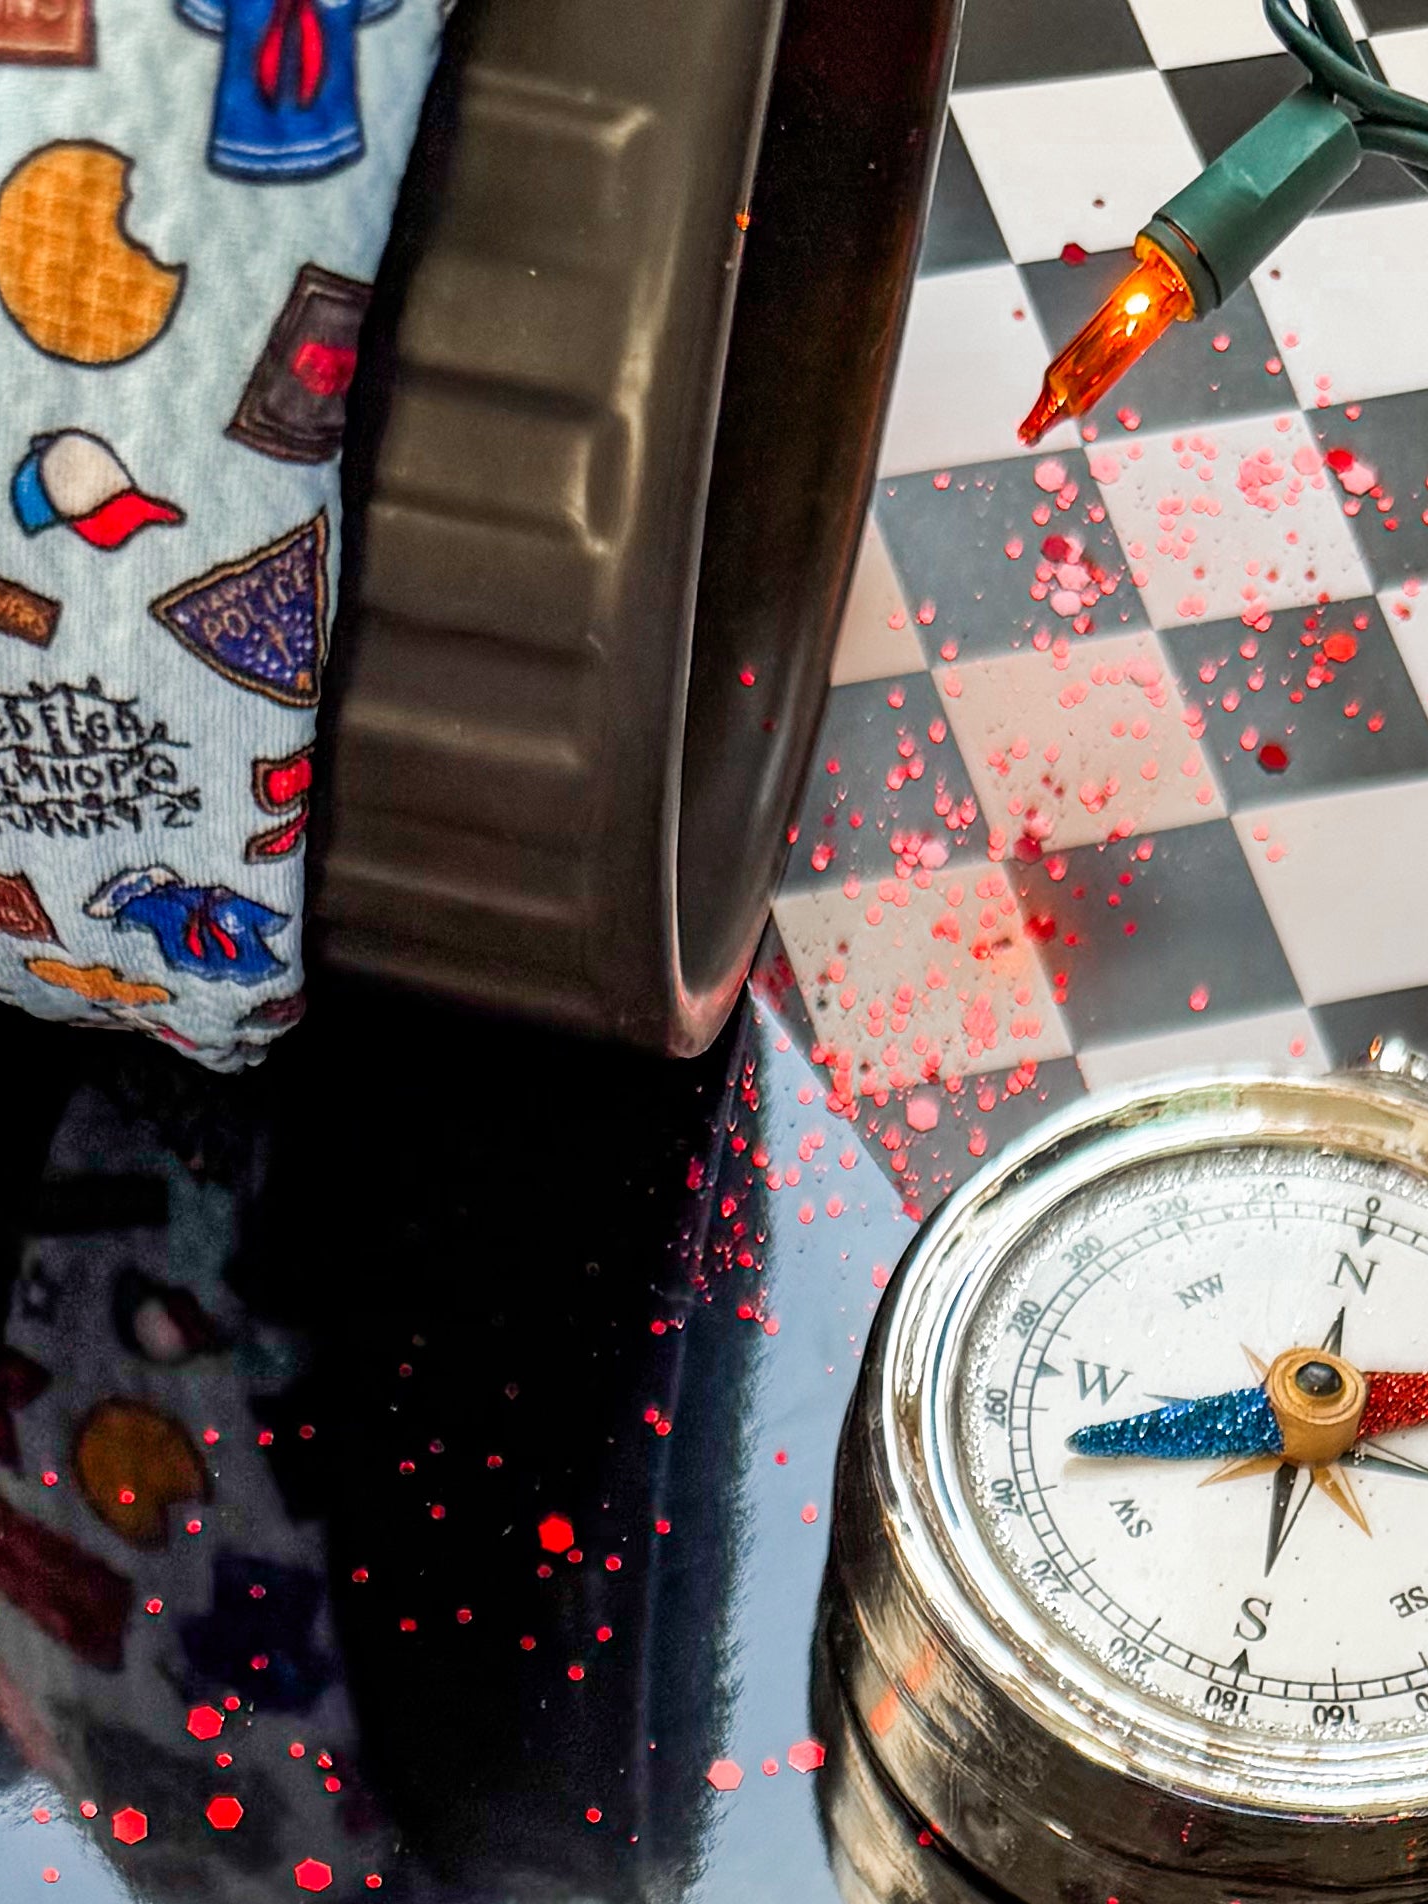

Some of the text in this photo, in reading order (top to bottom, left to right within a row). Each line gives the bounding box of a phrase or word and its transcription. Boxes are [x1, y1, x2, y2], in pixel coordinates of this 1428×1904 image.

[1145, 1196, 1190, 1222] 320
[1365, 1196, 1381, 1214] 0
[1060, 1236, 1105, 1270] 300
[1173, 1272, 1225, 1310] NW
[1327, 1250, 1380, 1296] N
[1006, 1300, 1042, 1338] 280
[1073, 1358, 1134, 1407] W
[984, 1388, 1008, 1428] 260
[990, 1478, 1023, 1517] 240
[1109, 1497, 1154, 1539] SW
[1031, 1559, 1072, 1594] 220
[1233, 1597, 1273, 1642] S
[1109, 1636, 1155, 1673] 200
[1205, 1685, 1249, 1715] 180
[1312, 1704, 1360, 1727] 160
